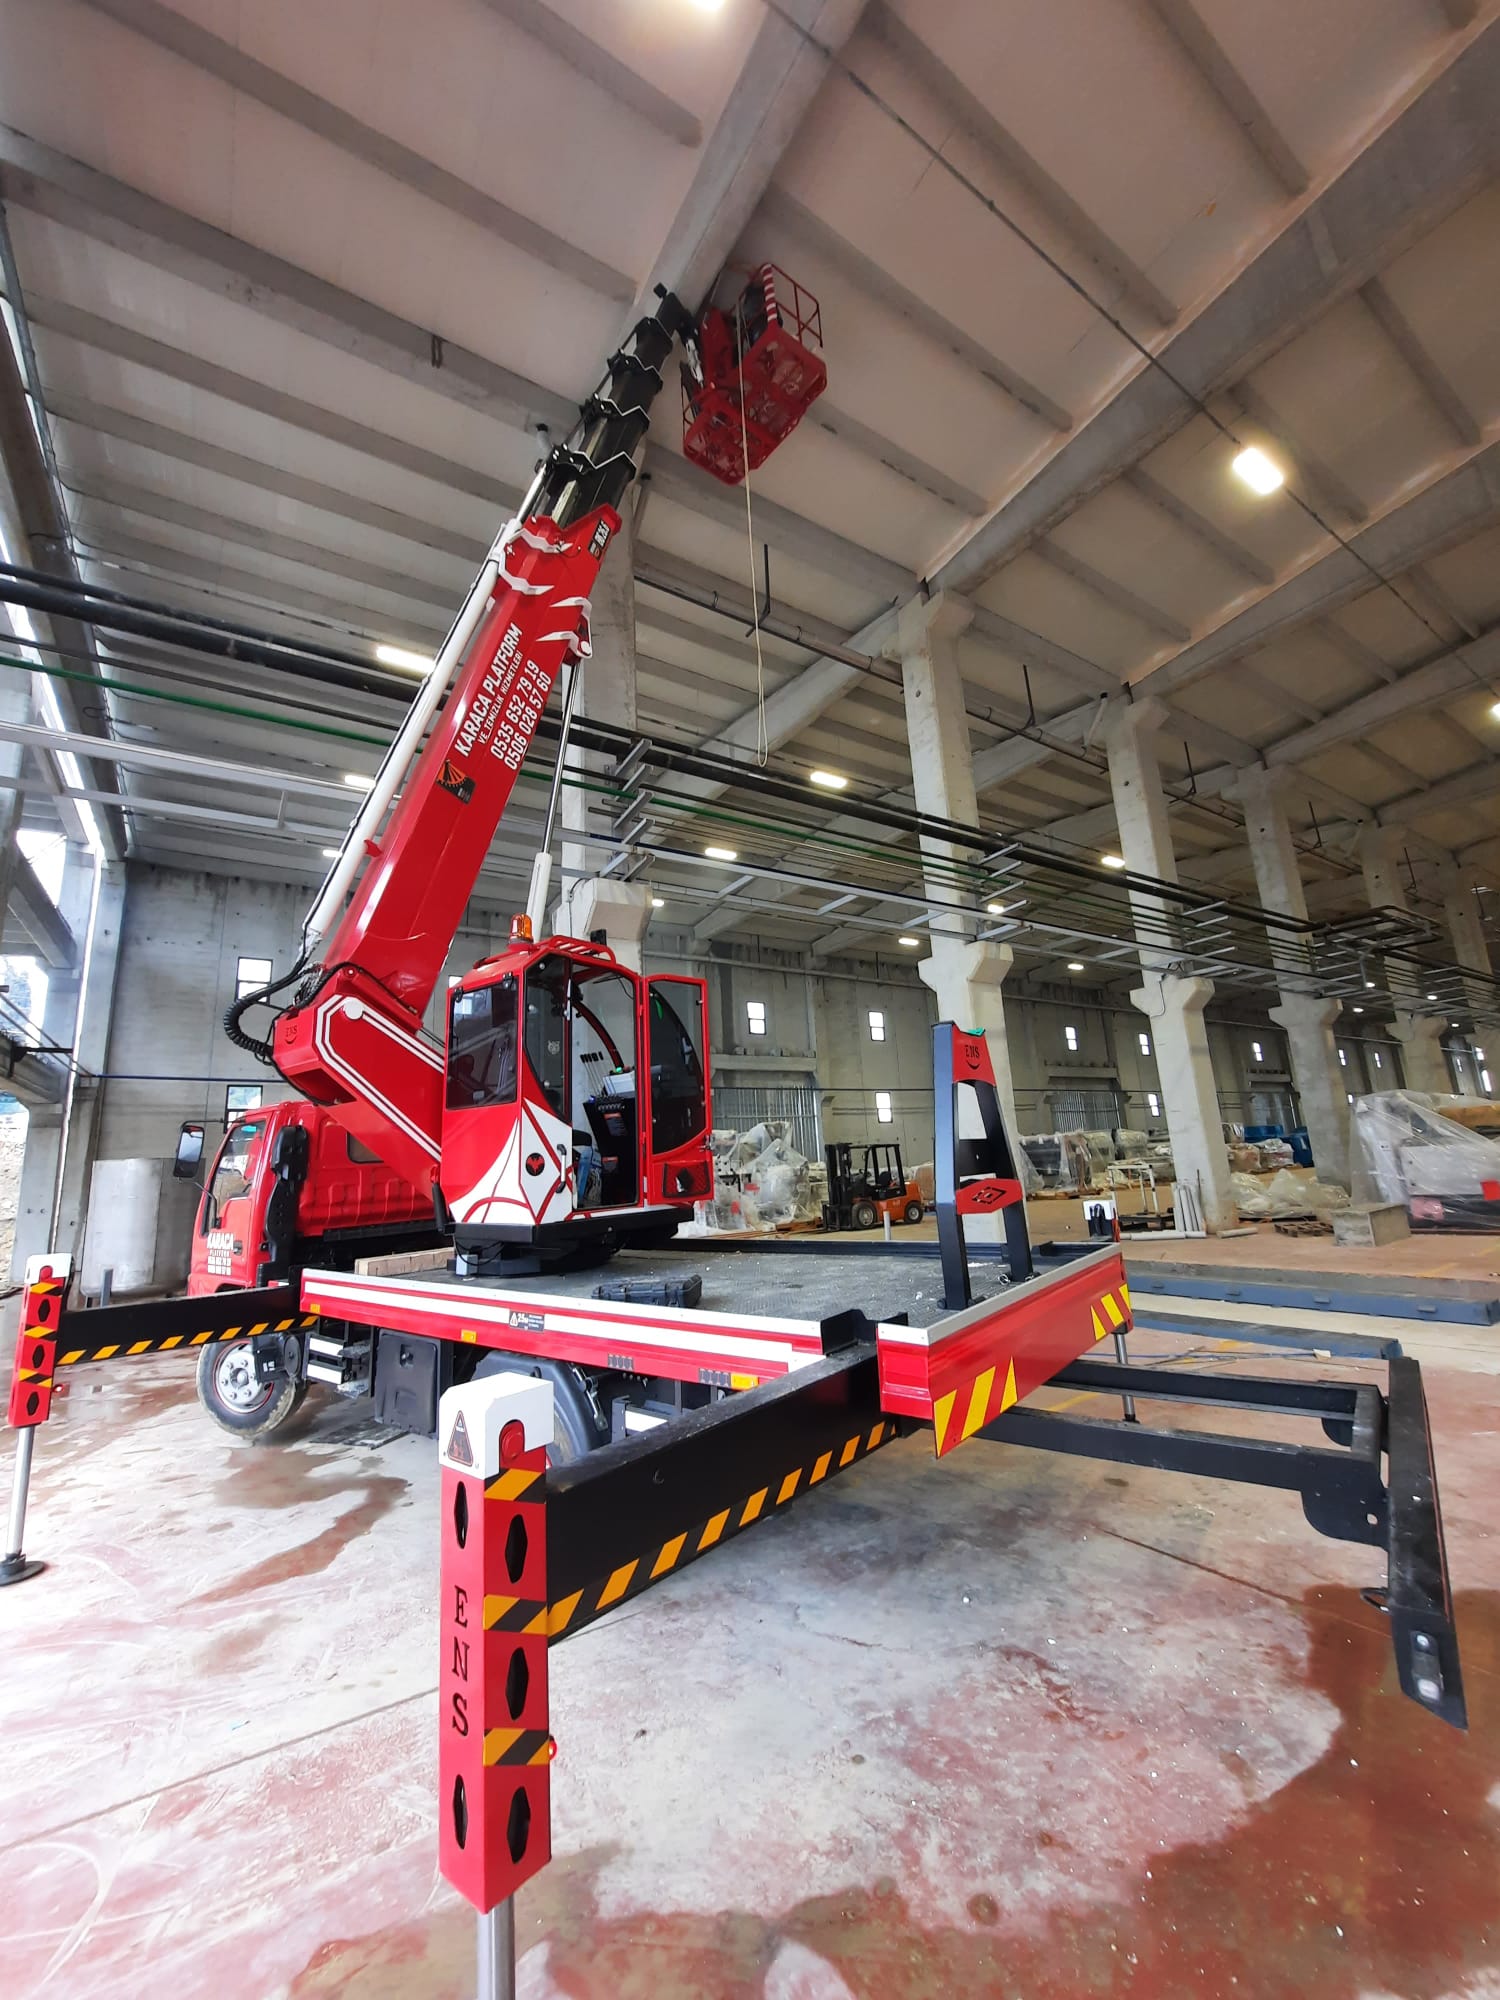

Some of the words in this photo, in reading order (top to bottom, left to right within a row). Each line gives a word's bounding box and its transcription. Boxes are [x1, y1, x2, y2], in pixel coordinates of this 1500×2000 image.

[524, 659, 540, 681] 19
[536, 670, 552, 692] 60
[454, 693, 492, 758] KARACA
[482, 622, 523, 697] PLATFORM
[516, 676, 533, 698] 79
[529, 687, 544, 710] 57
[505, 694, 526, 724] 652
[518, 706, 538, 735] 028
[477, 731, 488, 745] VE
[490, 721, 514, 760] 0535
[504, 732, 528, 770] 0506
[965, 1044, 980, 1058] ENS
[207, 1232, 234, 1250] KARACA
[452, 1584, 471, 1737] ENS
